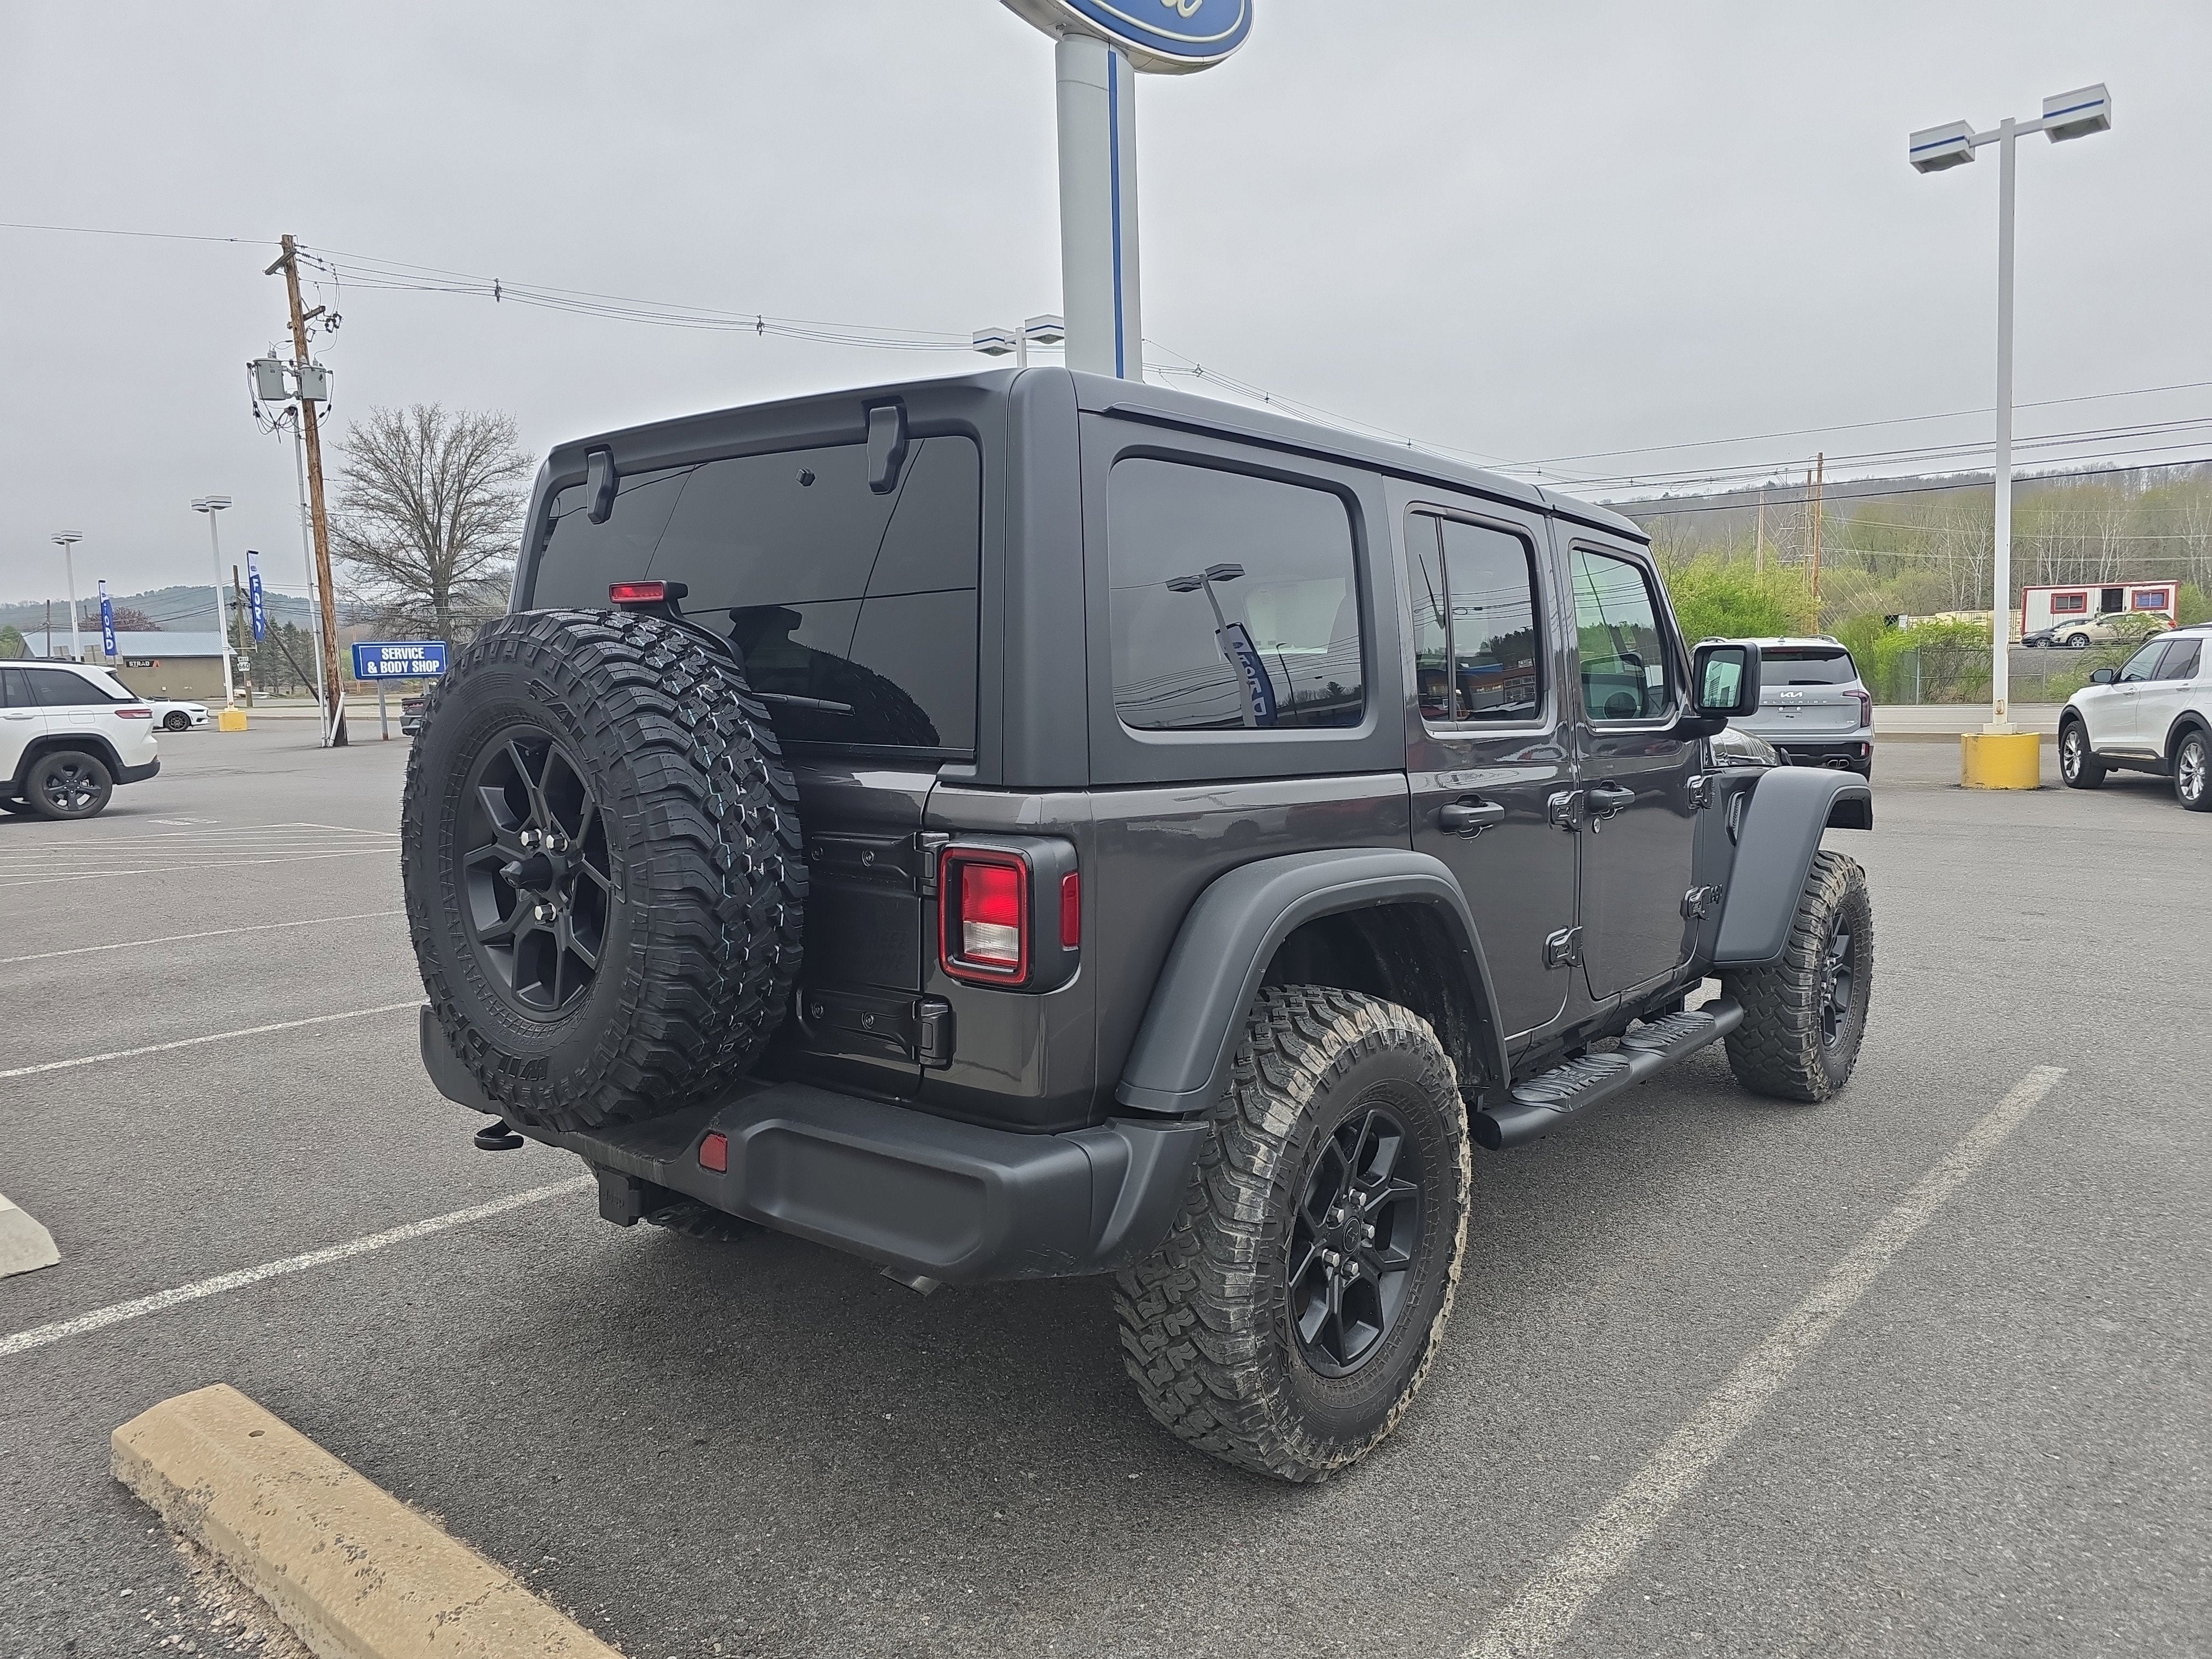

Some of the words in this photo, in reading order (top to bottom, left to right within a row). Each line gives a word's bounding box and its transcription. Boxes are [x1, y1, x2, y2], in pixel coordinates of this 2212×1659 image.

[381, 648, 425, 660] SERVICE
[368, 662, 377, 673] &
[381, 661, 409, 673] BODY
[412, 660, 439, 672] SHOP
